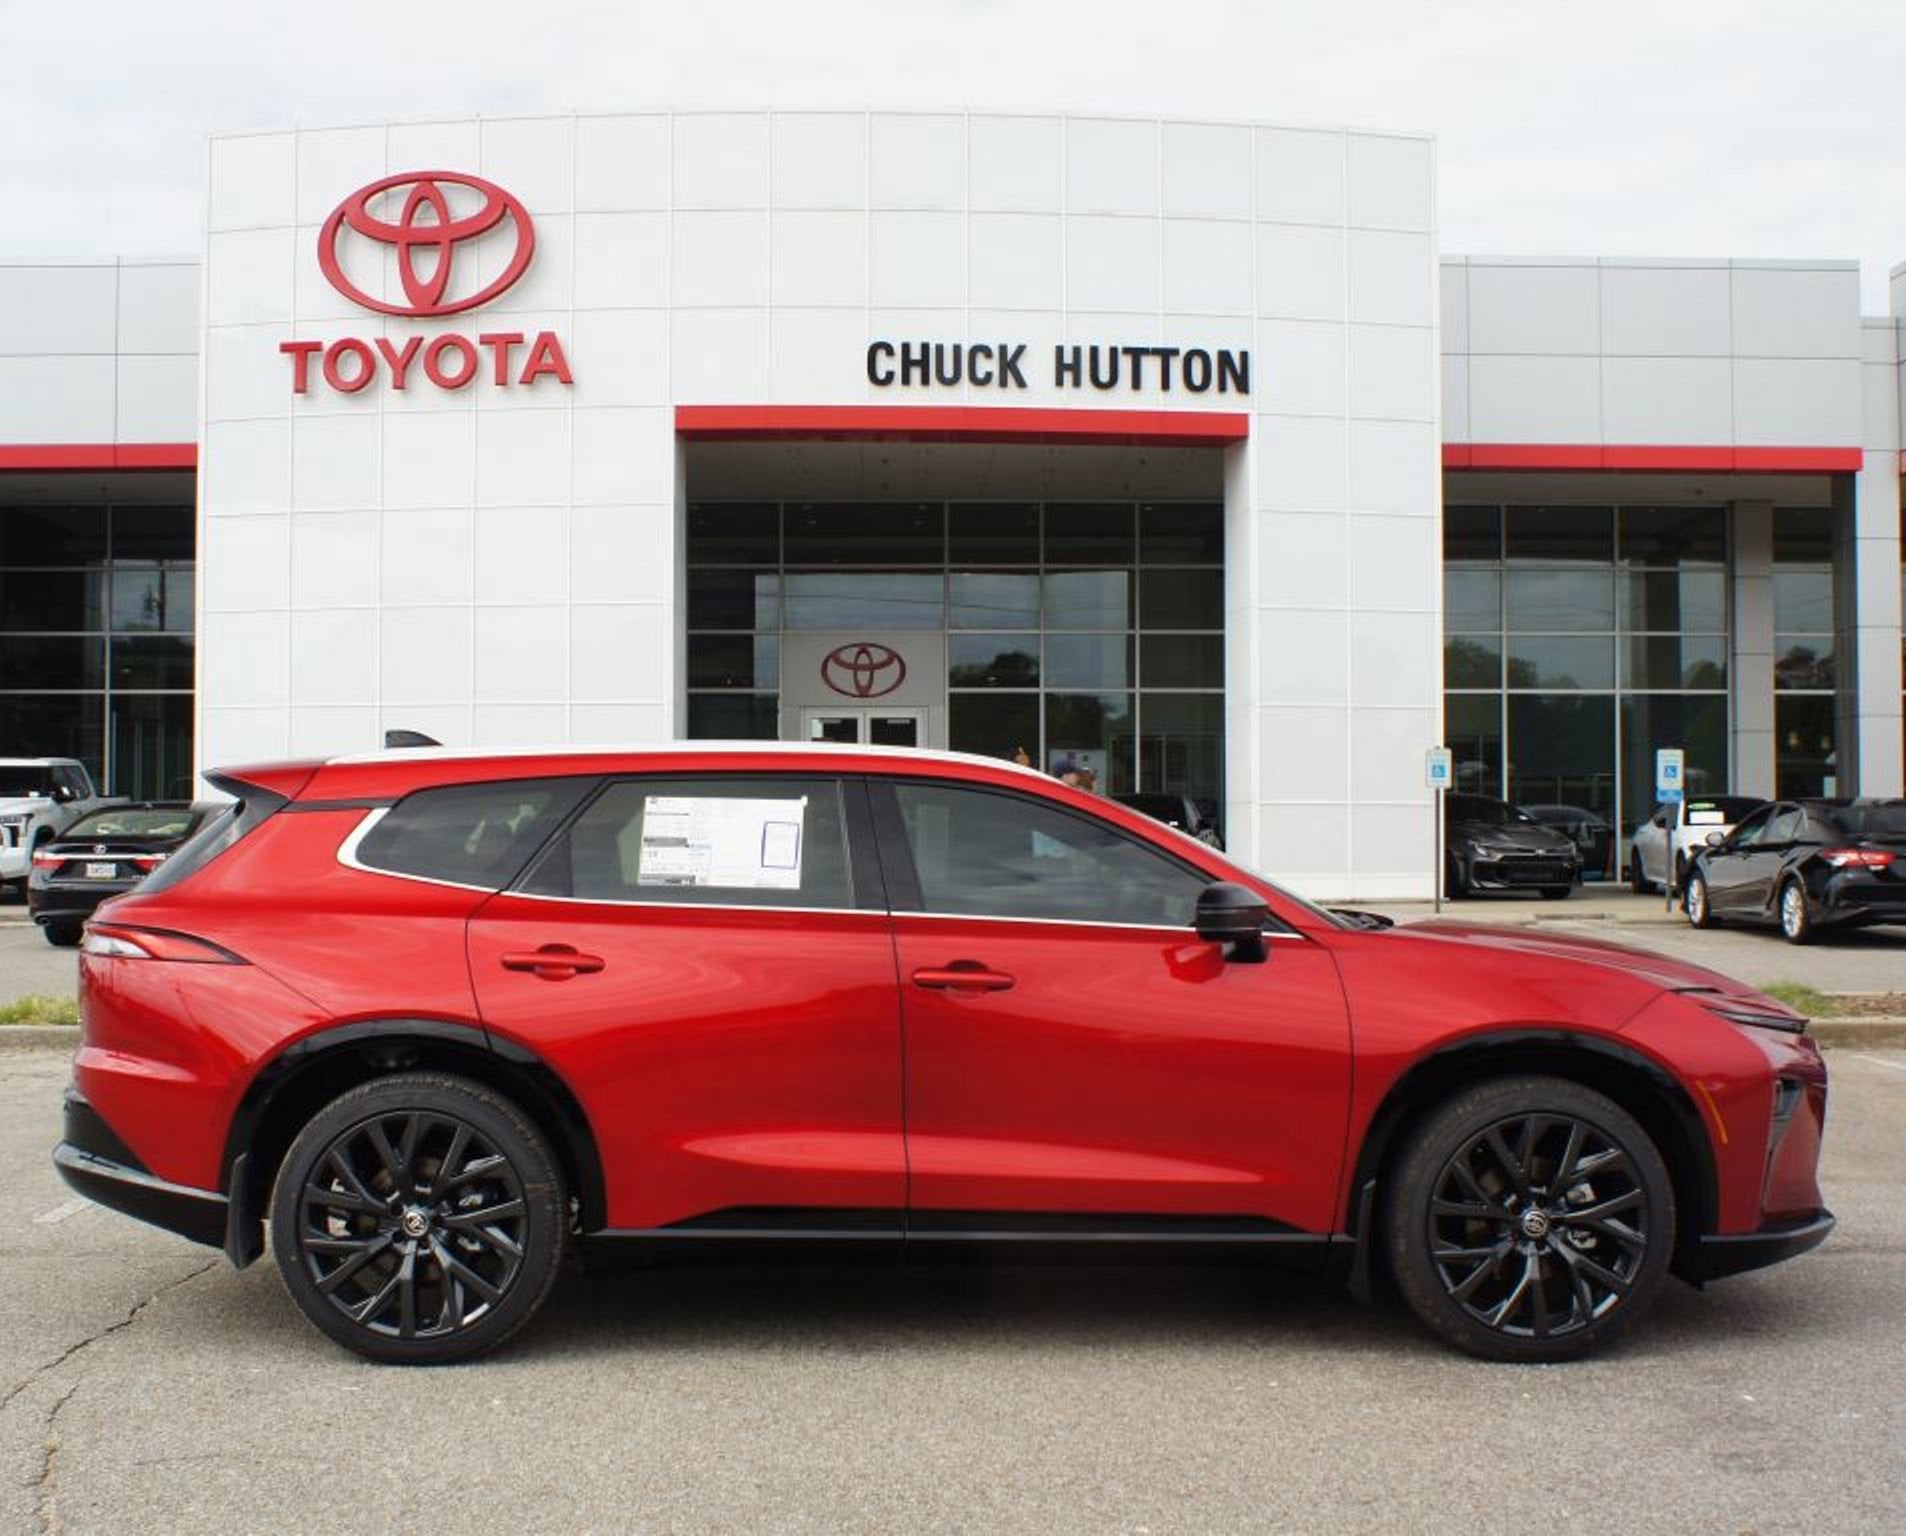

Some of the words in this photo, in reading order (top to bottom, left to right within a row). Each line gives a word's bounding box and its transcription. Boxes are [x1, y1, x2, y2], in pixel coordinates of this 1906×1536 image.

[280, 331, 574, 393] TOYOTA
[867, 341, 1027, 388] CHUCK
[1055, 345, 1250, 394] HUTTON
